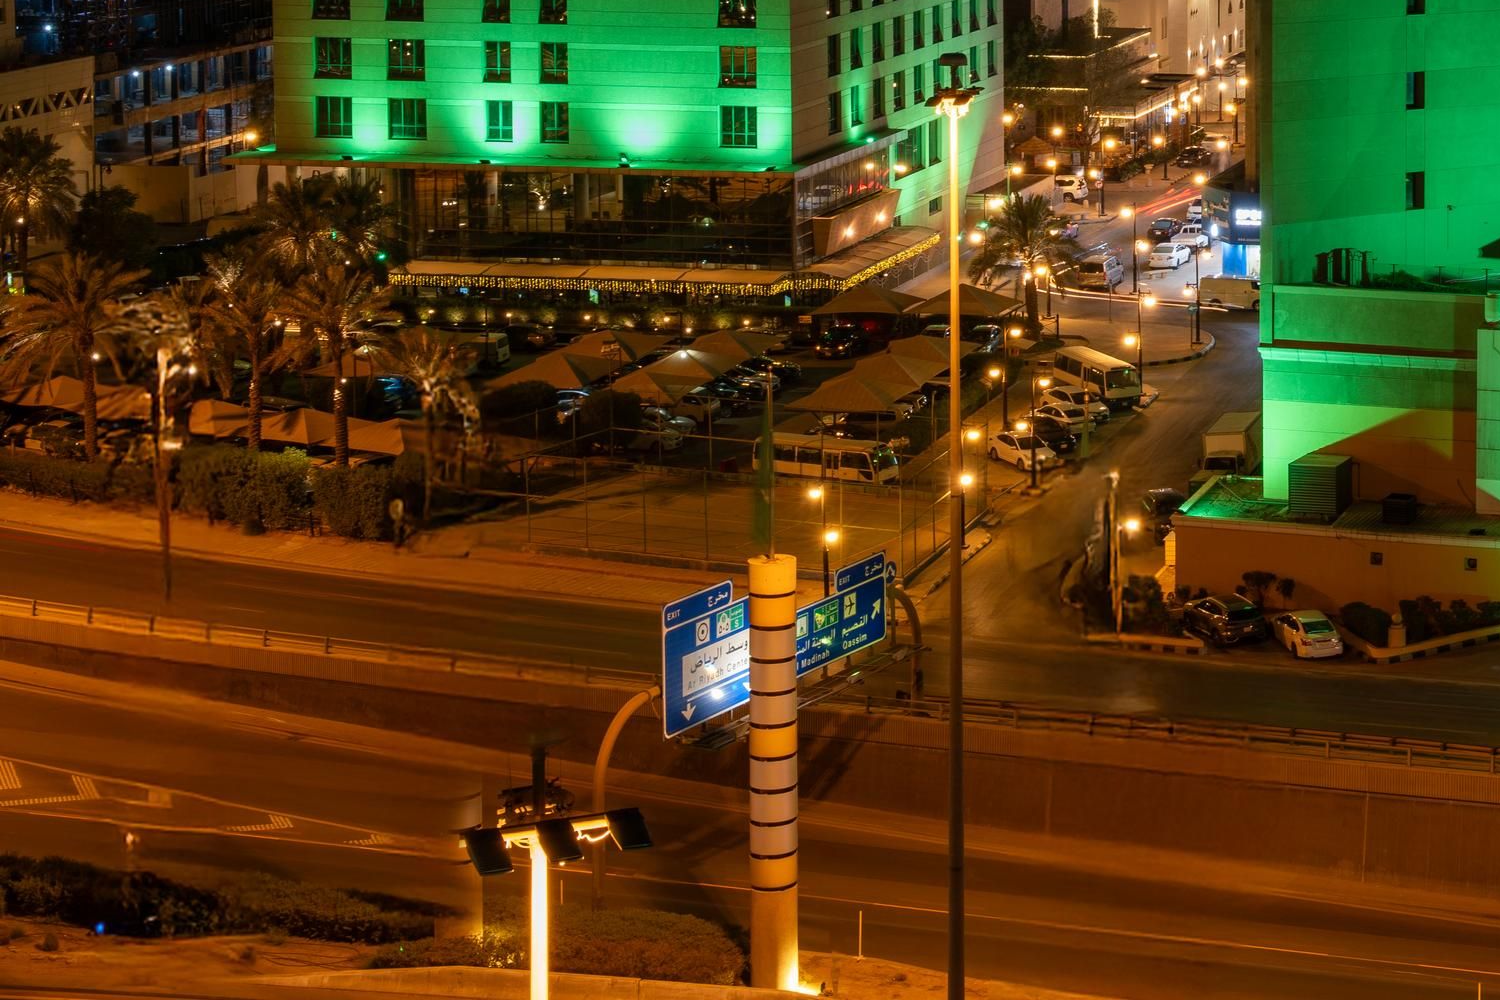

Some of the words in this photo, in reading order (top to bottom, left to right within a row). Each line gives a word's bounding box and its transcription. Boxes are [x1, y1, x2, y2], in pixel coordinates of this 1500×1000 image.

[838, 574, 851, 586] EXIT
[707, 591, 729, 607] مخرج
[666, 609, 681, 621] EXIT
[734, 619, 740, 629] S
[842, 613, 868, 638] القصيم
[842, 634, 868, 649] Qassim
[690, 646, 722, 673] الرياض
[727, 658, 748, 672] Cente
[801, 649, 830, 668] Madinah
